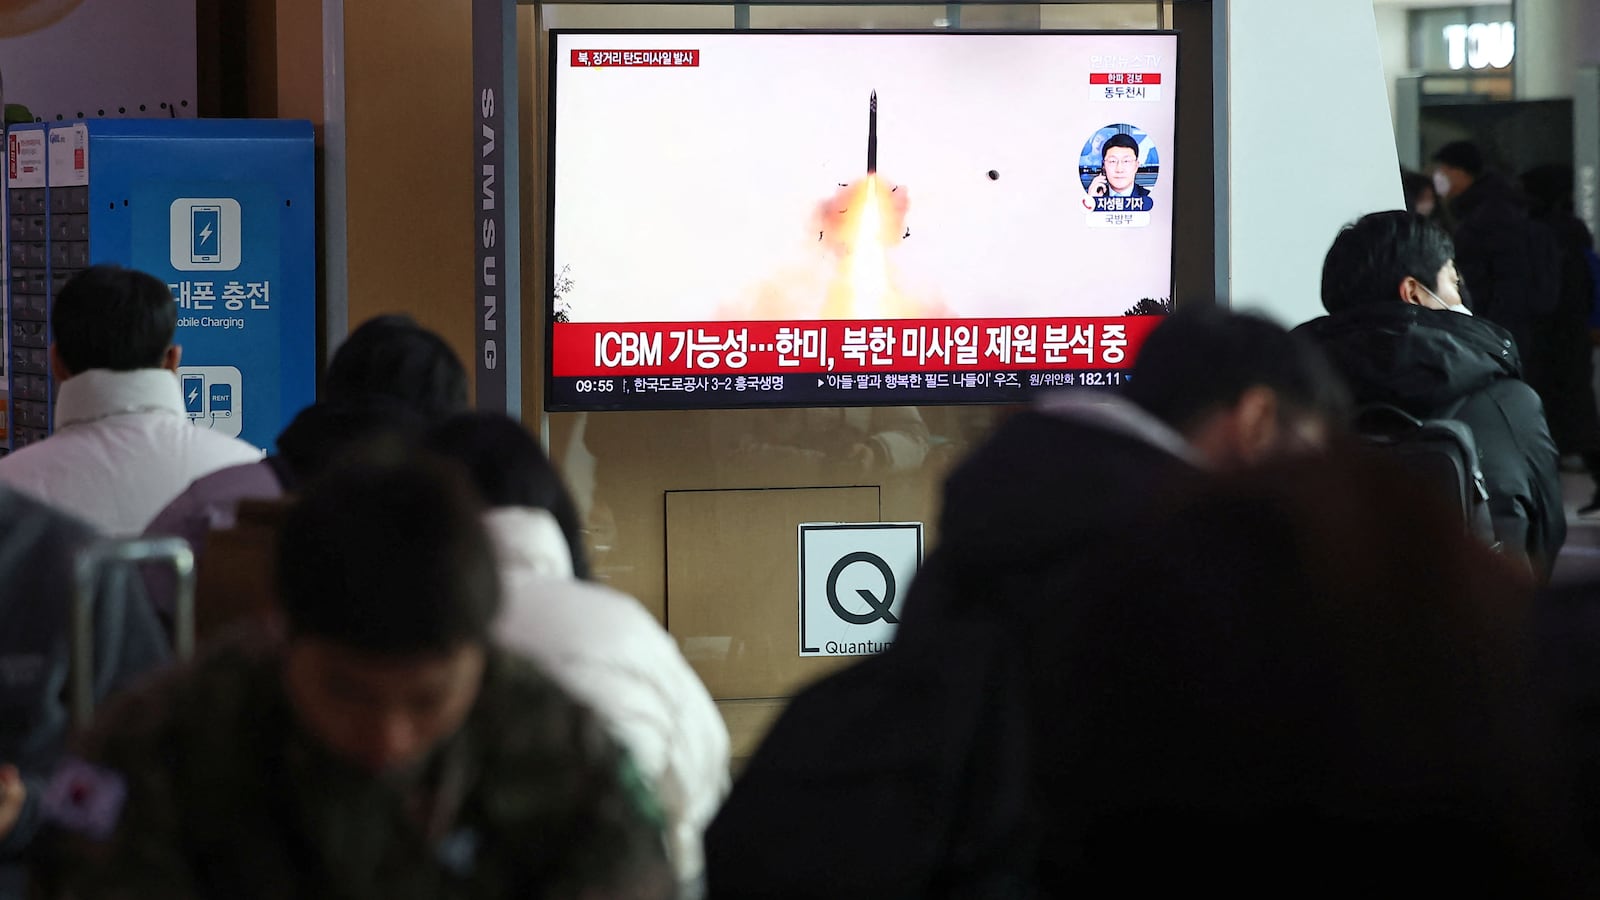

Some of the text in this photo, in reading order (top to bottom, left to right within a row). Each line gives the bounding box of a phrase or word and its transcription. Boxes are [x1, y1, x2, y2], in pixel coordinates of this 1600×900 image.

[578, 52, 693, 66] 북, 장거리 탄도미사일 발사
[1108, 73, 1143, 84] 한파 경보
[1105, 87, 1145, 99] 동두천시
[1097, 197, 1144, 210] 지성림 기자
[1106, 214, 1133, 225] 국방부
[481, 88, 497, 370] SAMSUNG
[167, 281, 270, 311] 대폰 충전
[176, 317, 244, 329] obile Charging
[594, 331, 663, 367] ICBM
[841, 326, 896, 366] 북한
[902, 325, 978, 366] 미사일
[984, 324, 1037, 364] 제원
[1042, 323, 1094, 363] 분석
[1100, 324, 1128, 363] 중
[576, 380, 614, 393] 09:55
[634, 377, 709, 392] 한국도로공사
[711, 377, 732, 391] 3-2
[734, 376, 784, 391] 흥국생명
[884, 374, 922, 389] 행복한
[925, 373, 950, 389] 필드
[993, 372, 1021, 388] 우즈,
[1029, 372, 1120, 387] 원/위안화 182.11
[826, 551, 899, 625] Q
